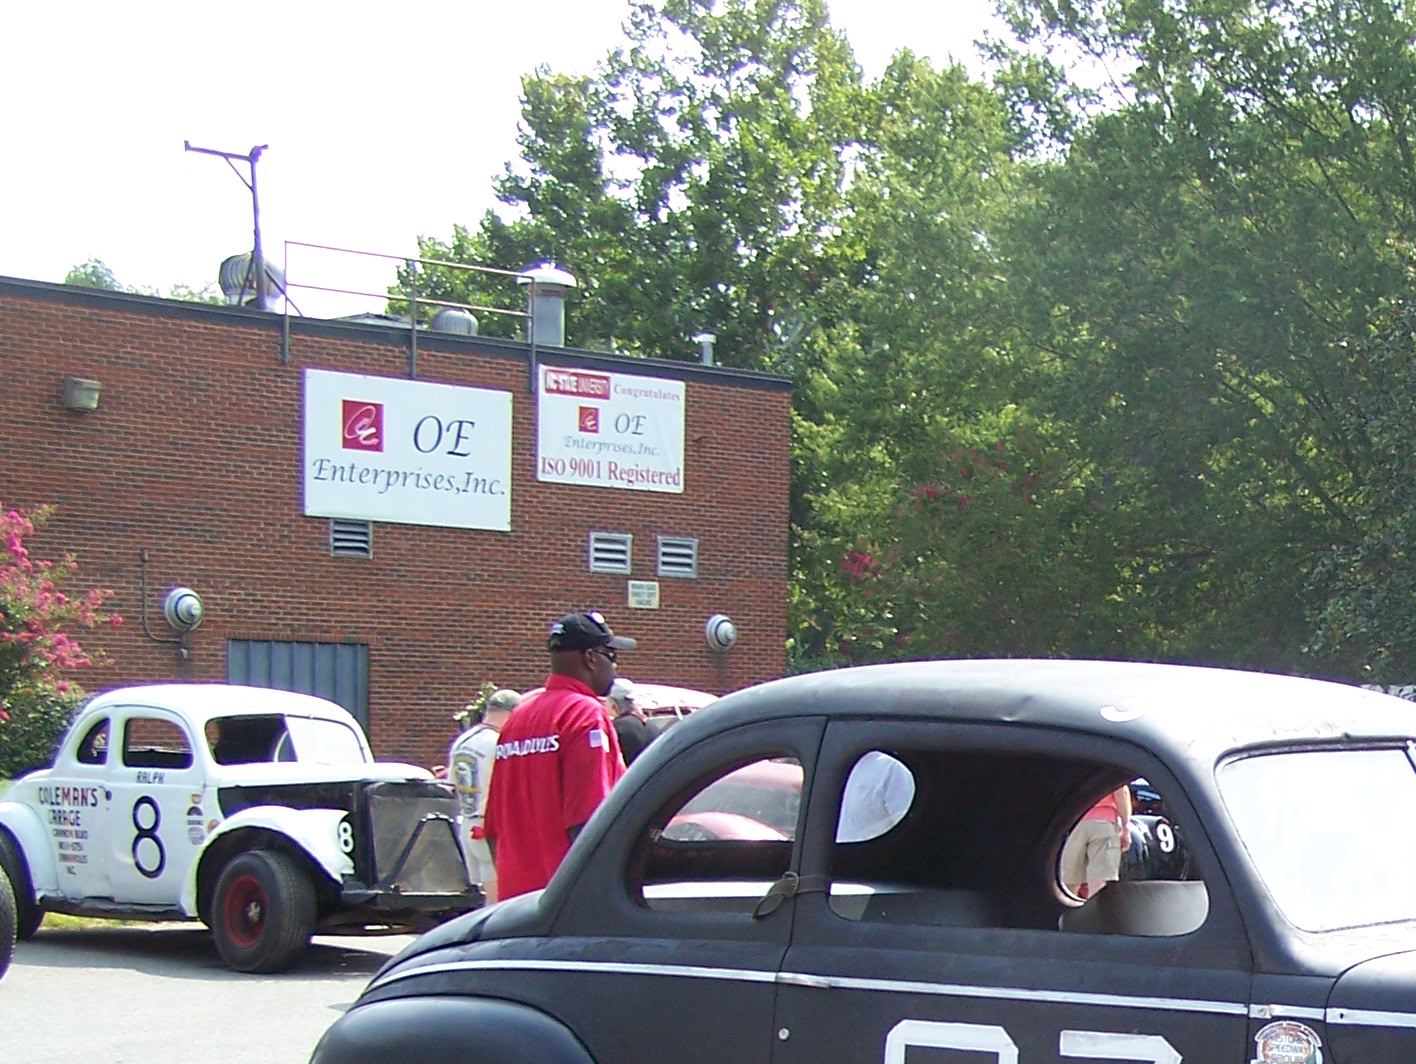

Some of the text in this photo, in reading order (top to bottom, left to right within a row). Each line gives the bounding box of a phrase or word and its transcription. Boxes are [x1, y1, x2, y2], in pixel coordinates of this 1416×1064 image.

[614, 383, 681, 401] Congratulates
[413, 415, 475, 457] OE
[615, 412, 647, 436] OE
[541, 456, 681, 487] ISO 9001 Registered
[137, 771, 165, 784] RALPH
[39, 786, 98, 807] COLEMAN'S
[132, 795, 167, 879] 8
[339, 821, 354, 853] 8
[1157, 823, 1174, 853] 9
